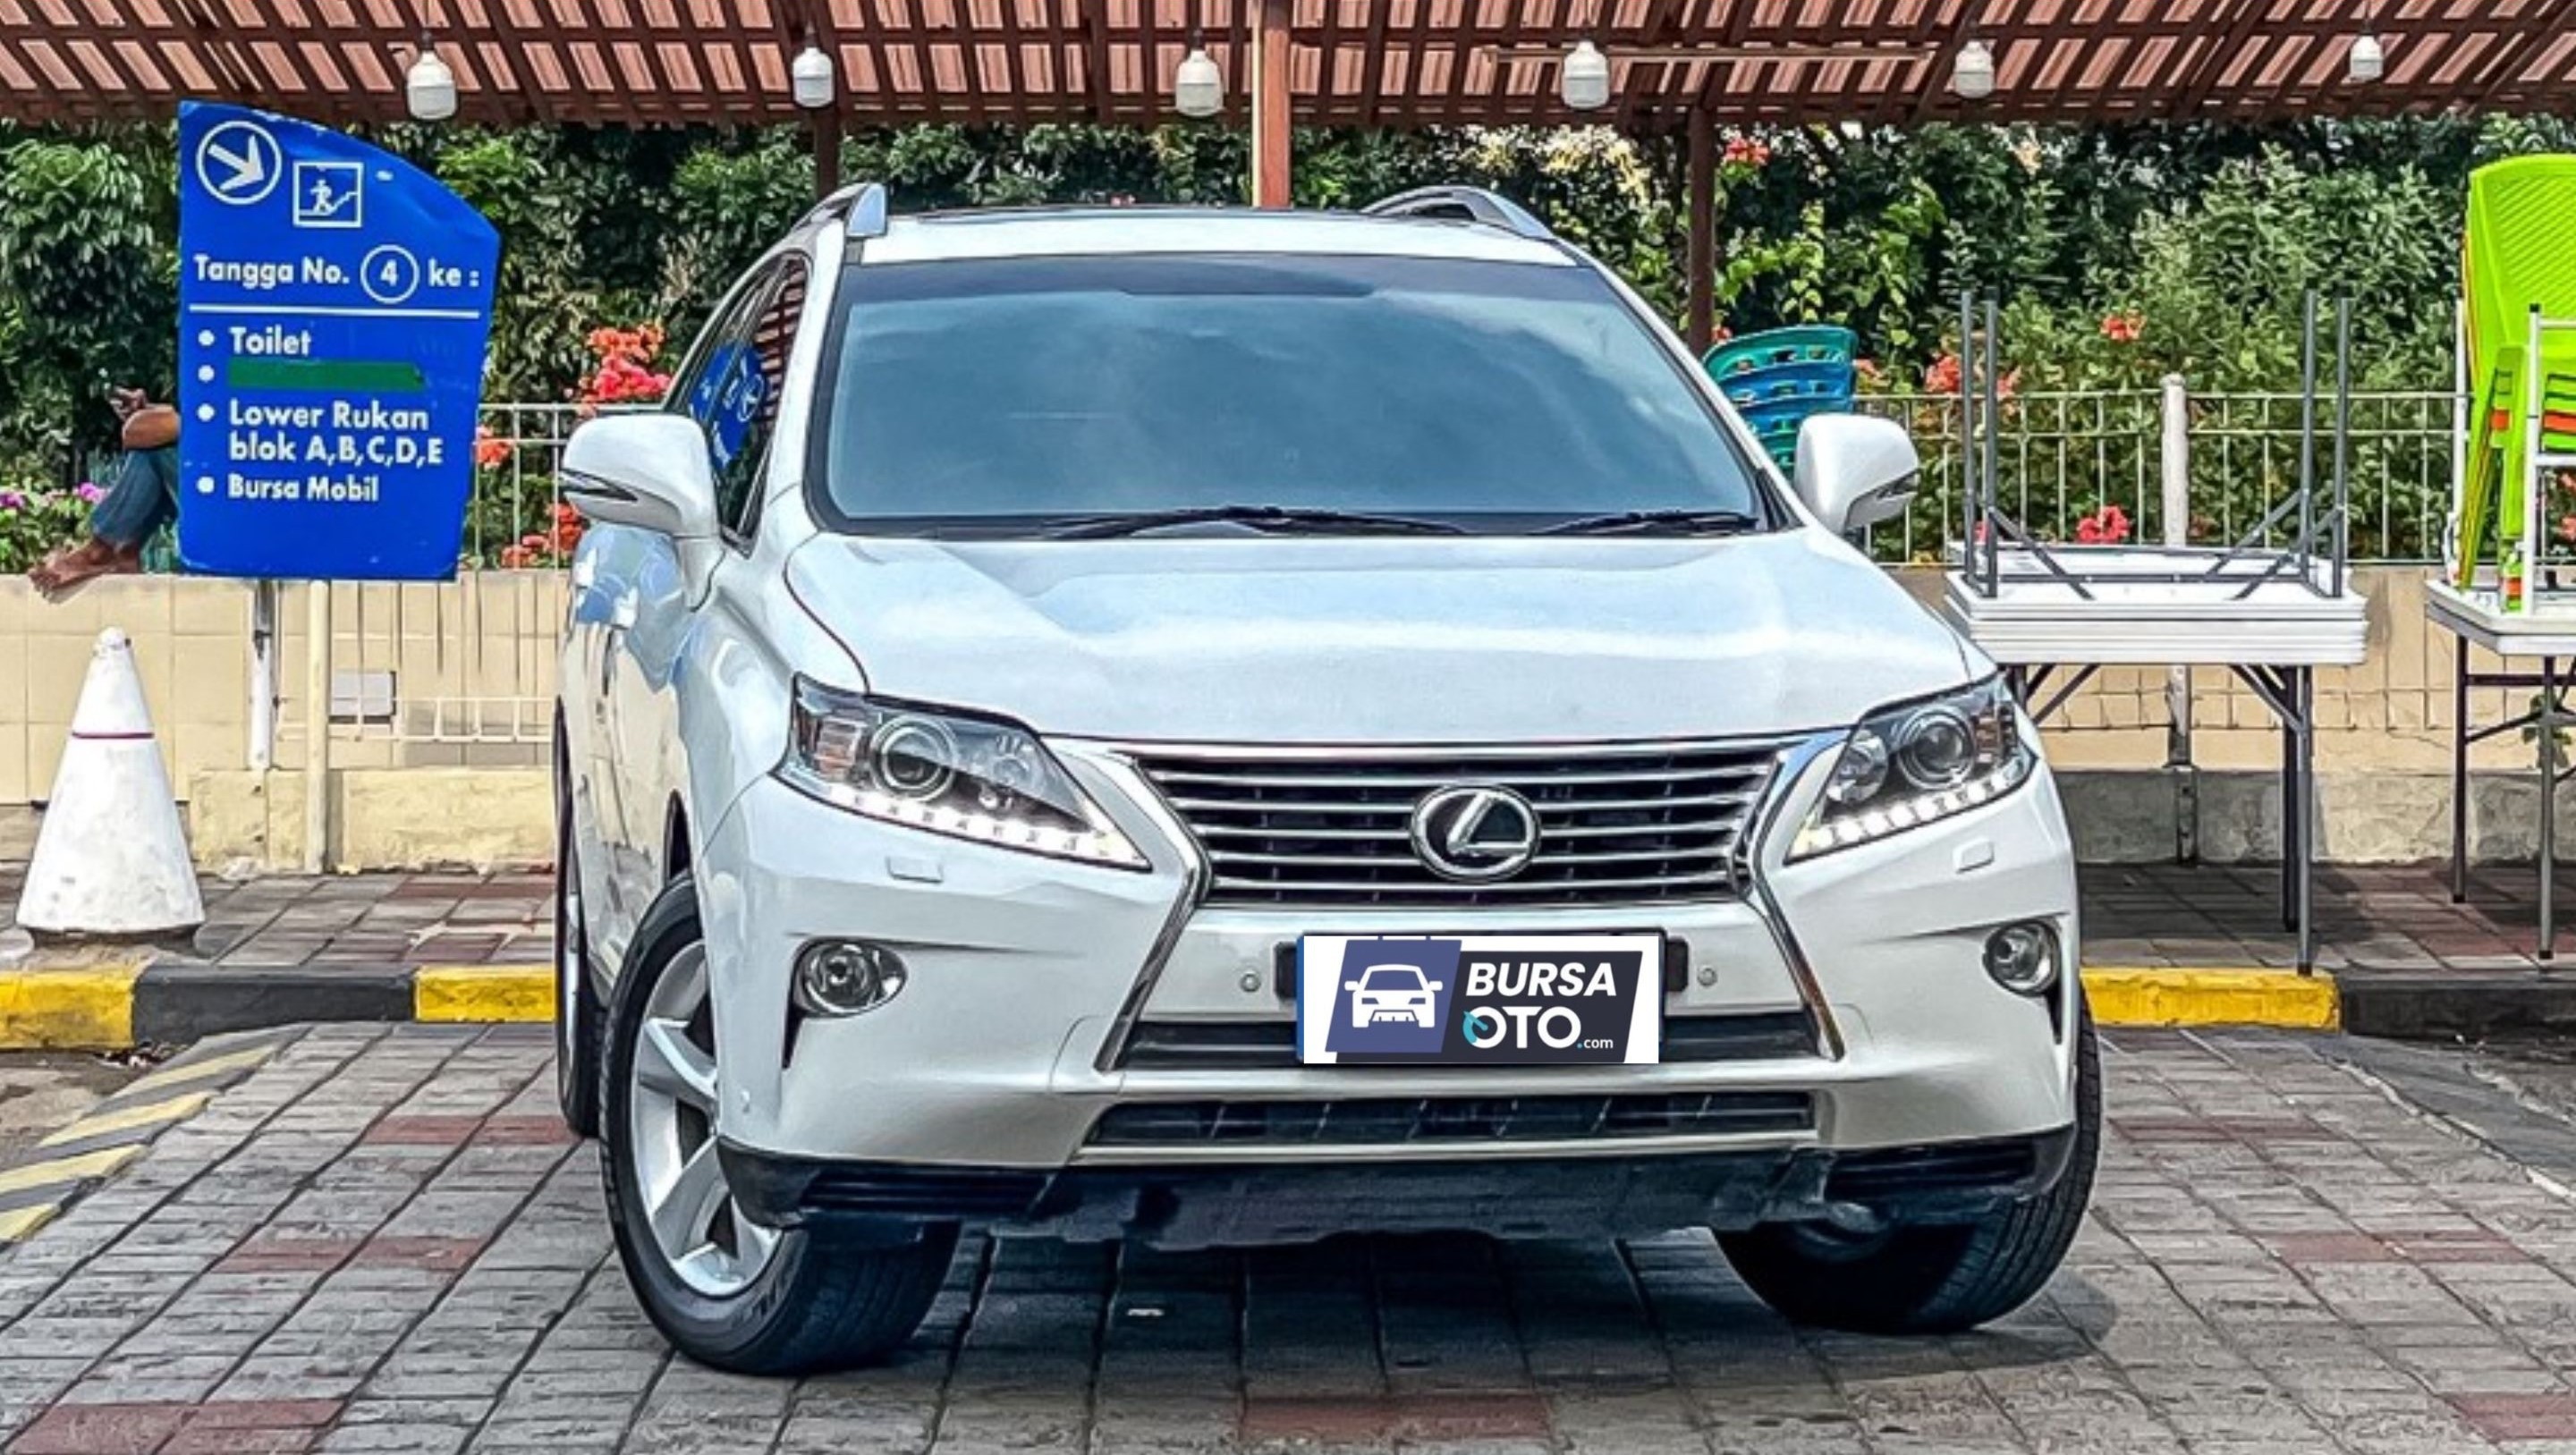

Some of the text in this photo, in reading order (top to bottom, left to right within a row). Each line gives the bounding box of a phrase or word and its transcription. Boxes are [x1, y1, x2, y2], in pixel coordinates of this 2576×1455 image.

[193, 254, 293, 289] Tangga
[301, 256, 350, 284] No.
[379, 258, 398, 286] 4
[229, 324, 311, 356] Toilet
[229, 398, 428, 429] Lower Rukan
[229, 430, 444, 469] blok A,B,C,D,E
[228, 473, 379, 502] Bursa Mobil
